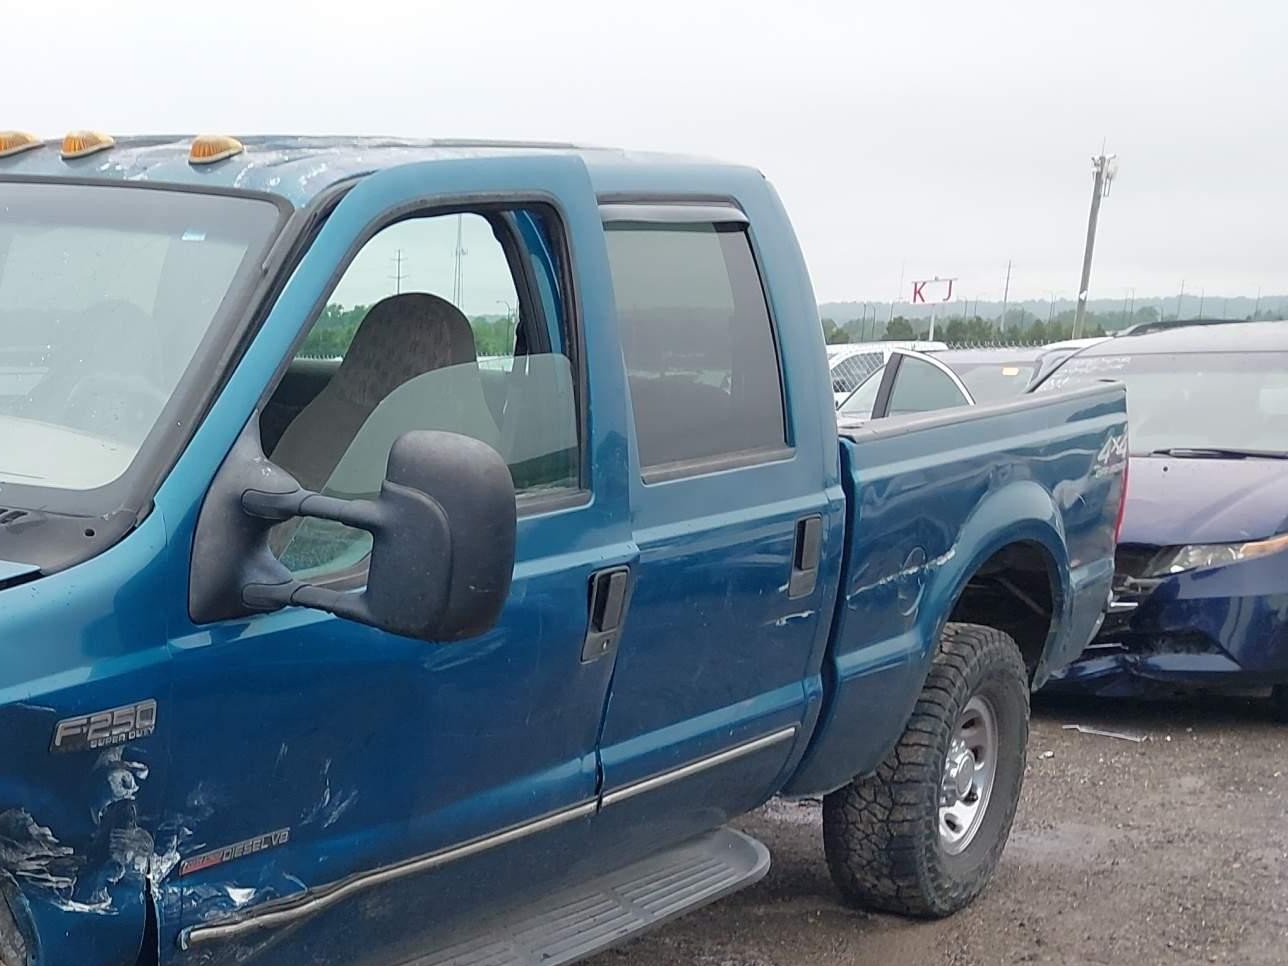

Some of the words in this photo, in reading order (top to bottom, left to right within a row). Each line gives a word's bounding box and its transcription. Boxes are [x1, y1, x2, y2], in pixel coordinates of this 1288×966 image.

[913, 281, 927, 303] K
[943, 280, 953, 302] J
[89, 733, 127, 749] SUPER
[128, 725, 156, 741] DUTY
[222, 839, 269, 862] DIESEL
